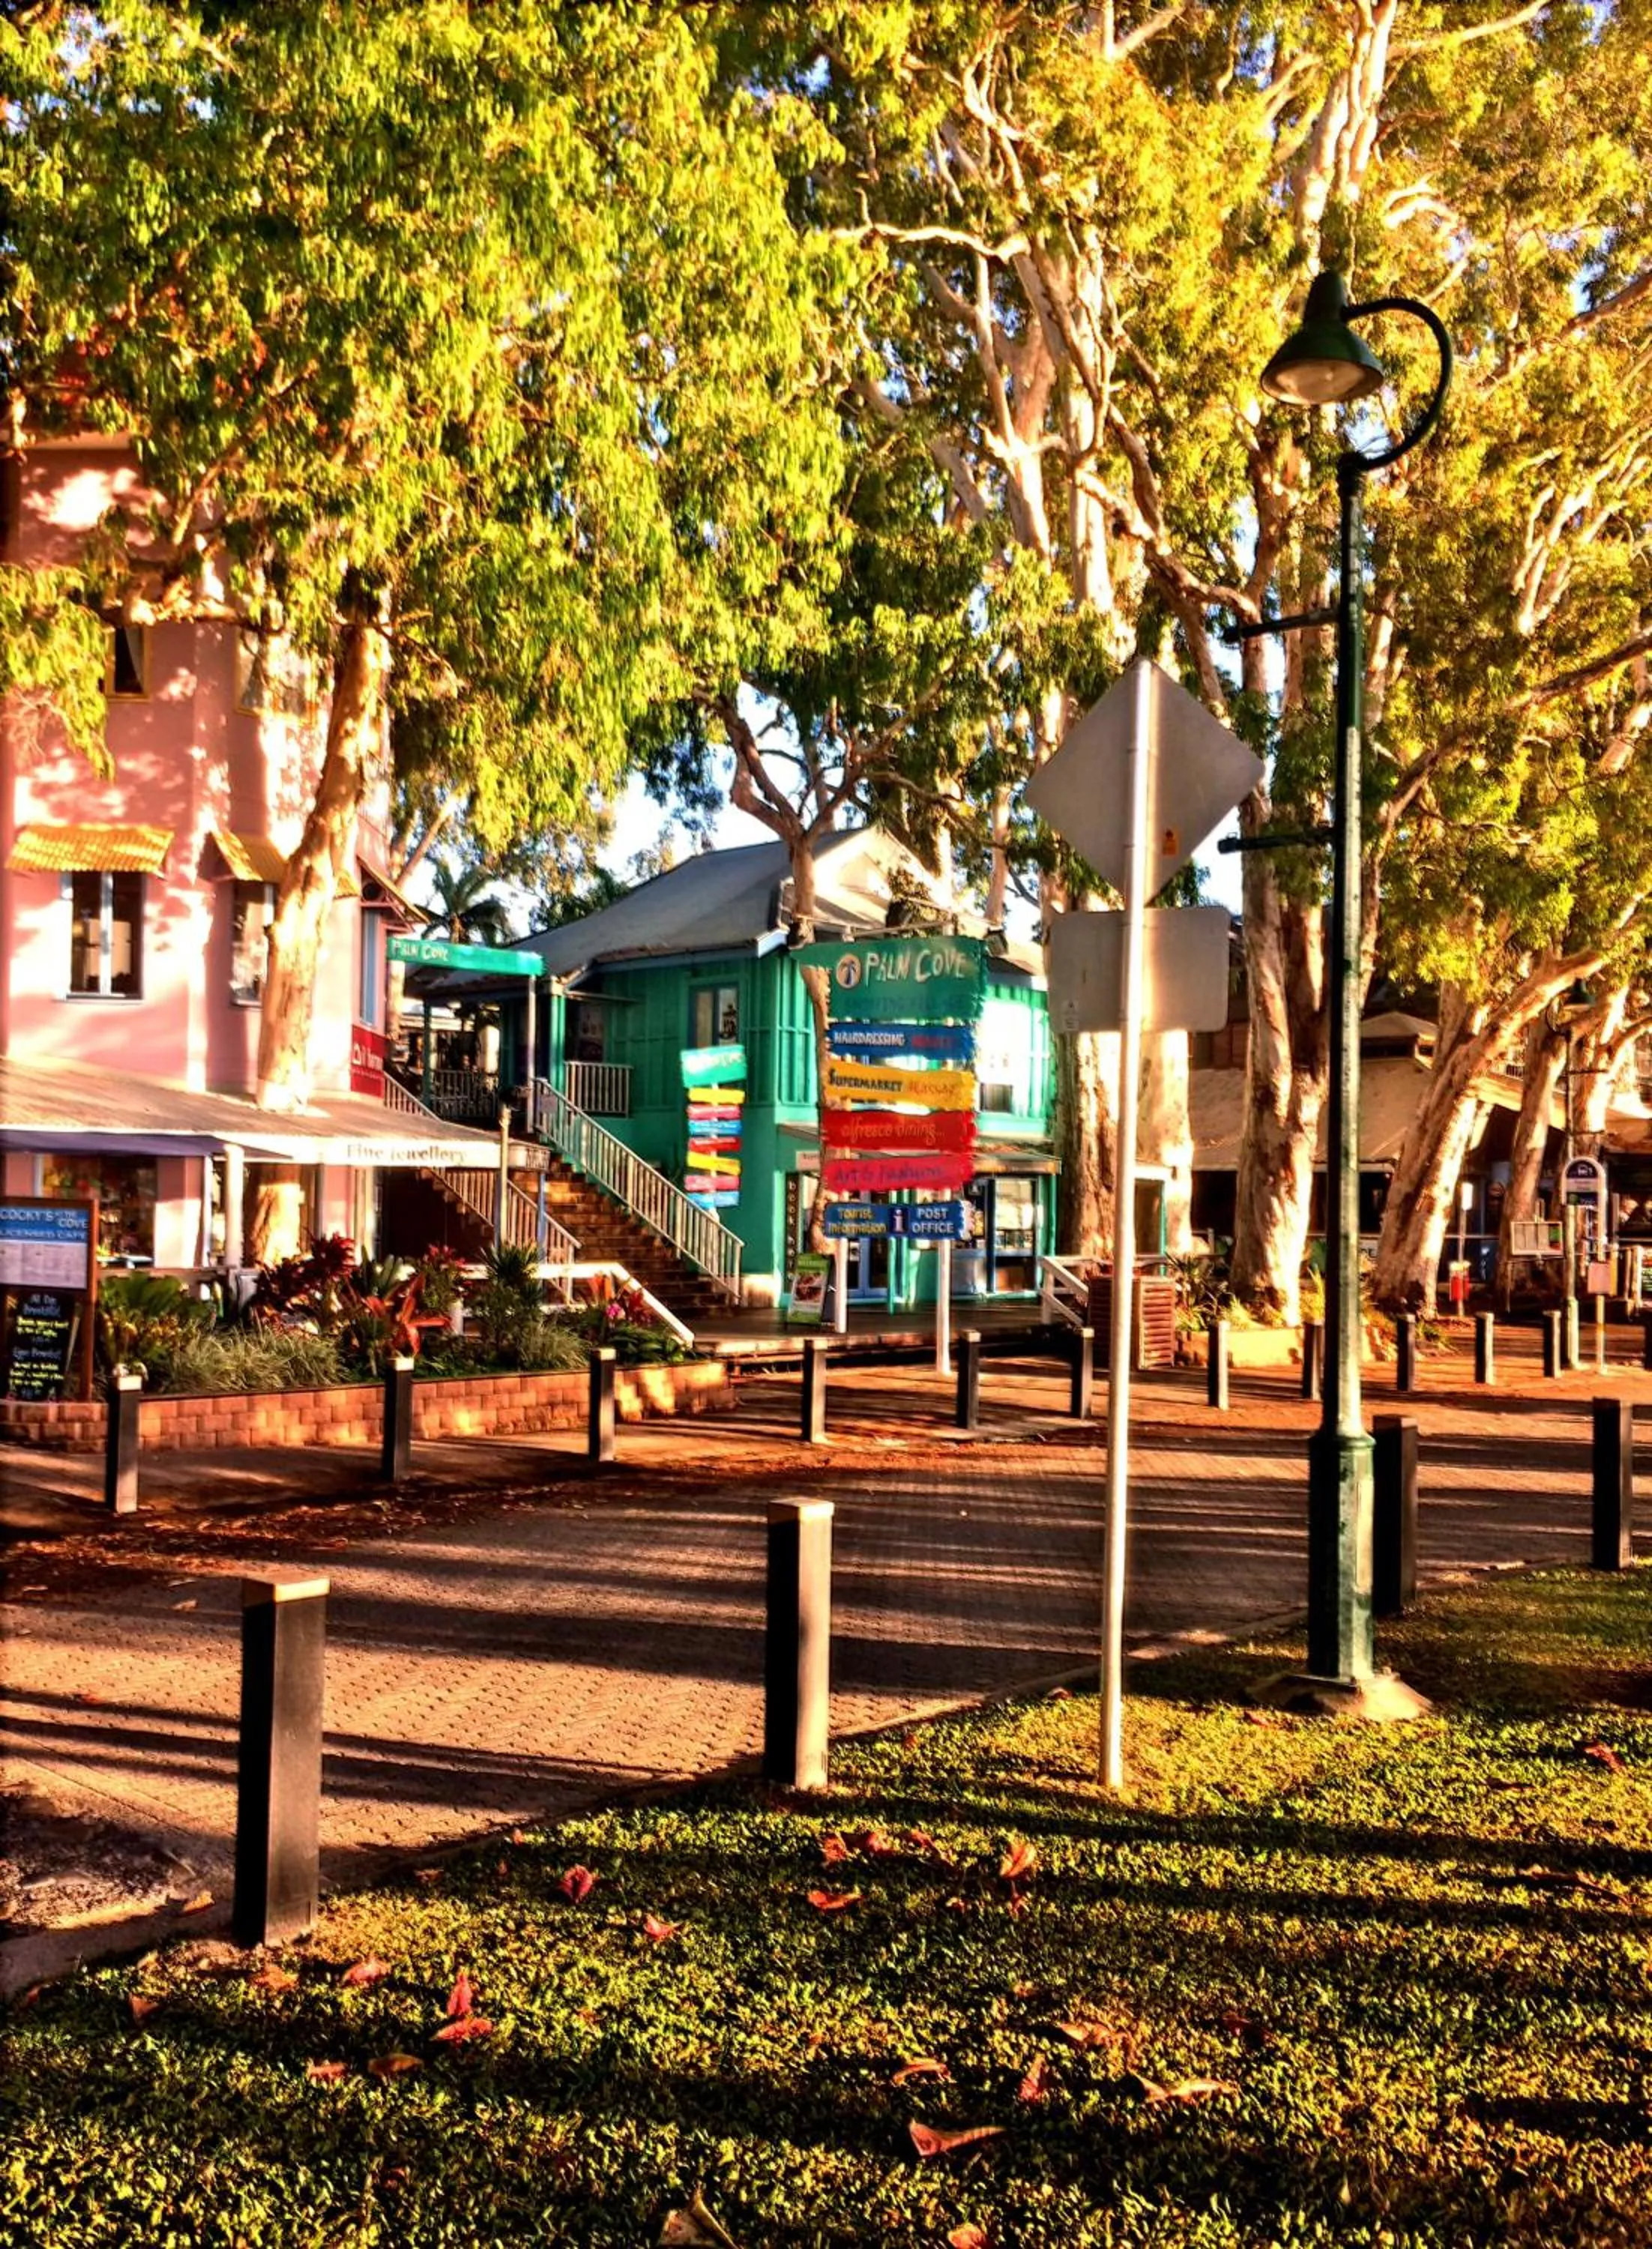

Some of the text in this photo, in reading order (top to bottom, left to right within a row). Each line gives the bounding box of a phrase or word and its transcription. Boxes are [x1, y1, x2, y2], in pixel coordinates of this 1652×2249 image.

[865, 948, 966, 987] PALM COVE
[833, 1031, 906, 1047] HAIRDRESSING
[829, 1068, 904, 1092] SUPERMARKET
[841, 1115, 894, 1144] alfresco
[917, 1208, 948, 1219] POST
[911, 1222, 954, 1234] OFFICE
